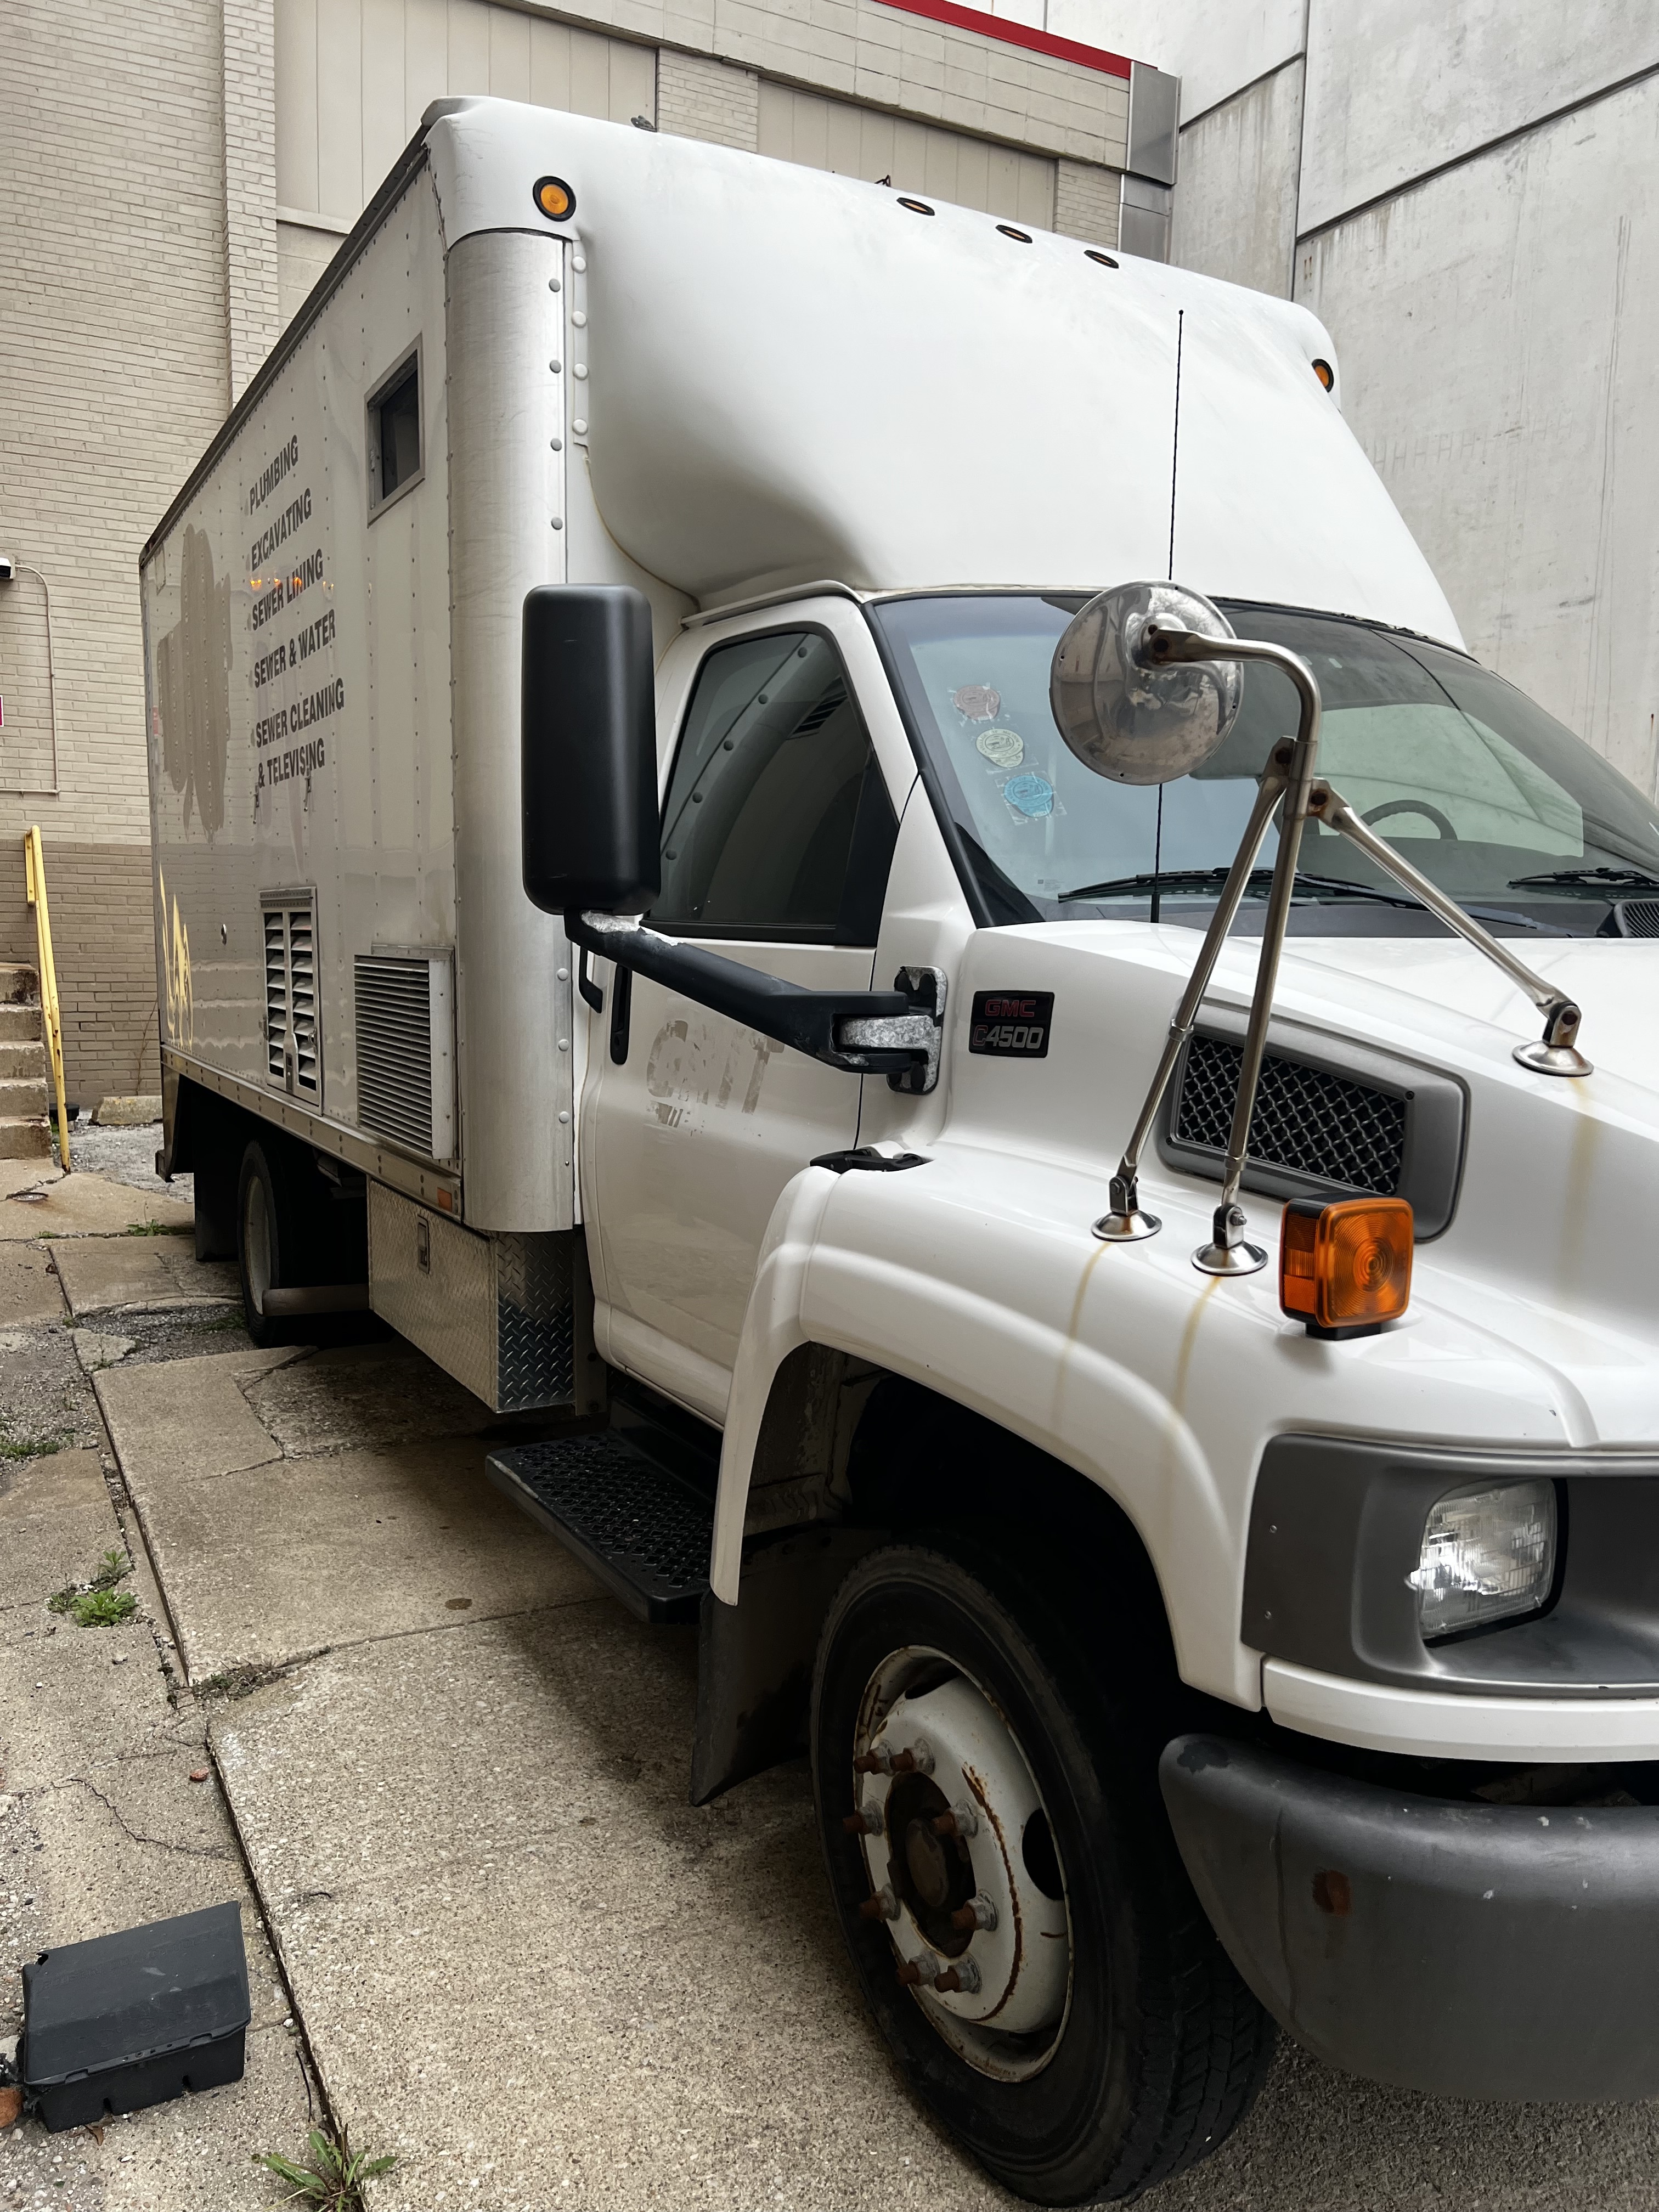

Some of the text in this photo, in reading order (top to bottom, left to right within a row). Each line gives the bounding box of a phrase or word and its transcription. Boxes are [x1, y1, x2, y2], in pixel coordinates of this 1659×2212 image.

[250, 435, 298, 516] PLUMBING
[251, 488, 312, 572] EXCAVATING
[252, 548, 323, 631] SEWER LINING
[255, 609, 336, 688] SEWER & WATER
[256, 678, 345, 748] SEWER CLEANING
[258, 738, 325, 788] & TELEVISING
[972, 1025, 1044, 1049] C4500
[985, 999, 1036, 1017] GMC
